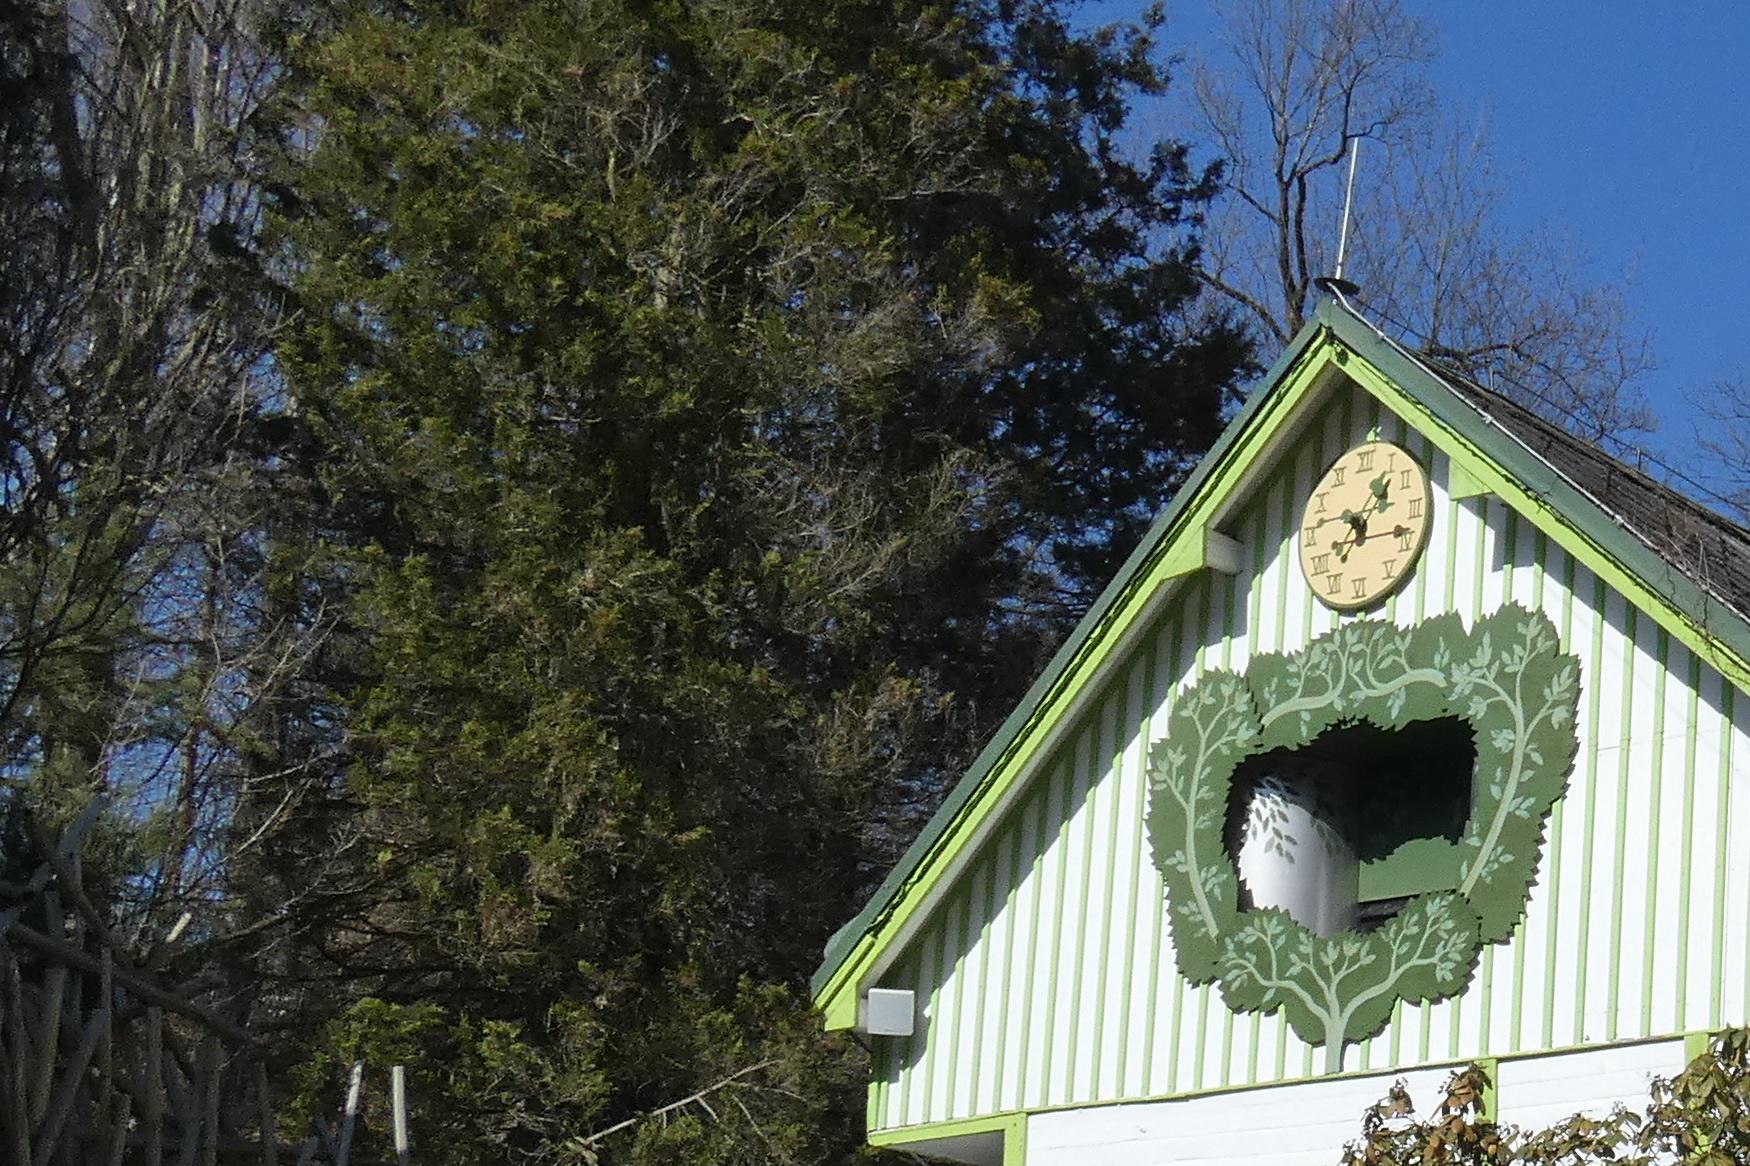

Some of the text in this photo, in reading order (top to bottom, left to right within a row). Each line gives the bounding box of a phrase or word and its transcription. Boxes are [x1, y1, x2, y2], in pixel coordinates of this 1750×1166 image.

[1356, 449, 1377, 475] XII
[1384, 452, 1397, 474] I
[1331, 466, 1347, 489] XI
[1400, 469, 1413, 490] II
[1314, 492, 1330, 514] X
[1408, 497, 1423, 520] III
[1399, 530, 1415, 553] IV
[1310, 553, 1332, 577] VIII
[1382, 559, 1397, 580] V
[1326, 572, 1343, 595] VII
[1351, 577, 1367, 600] VI
